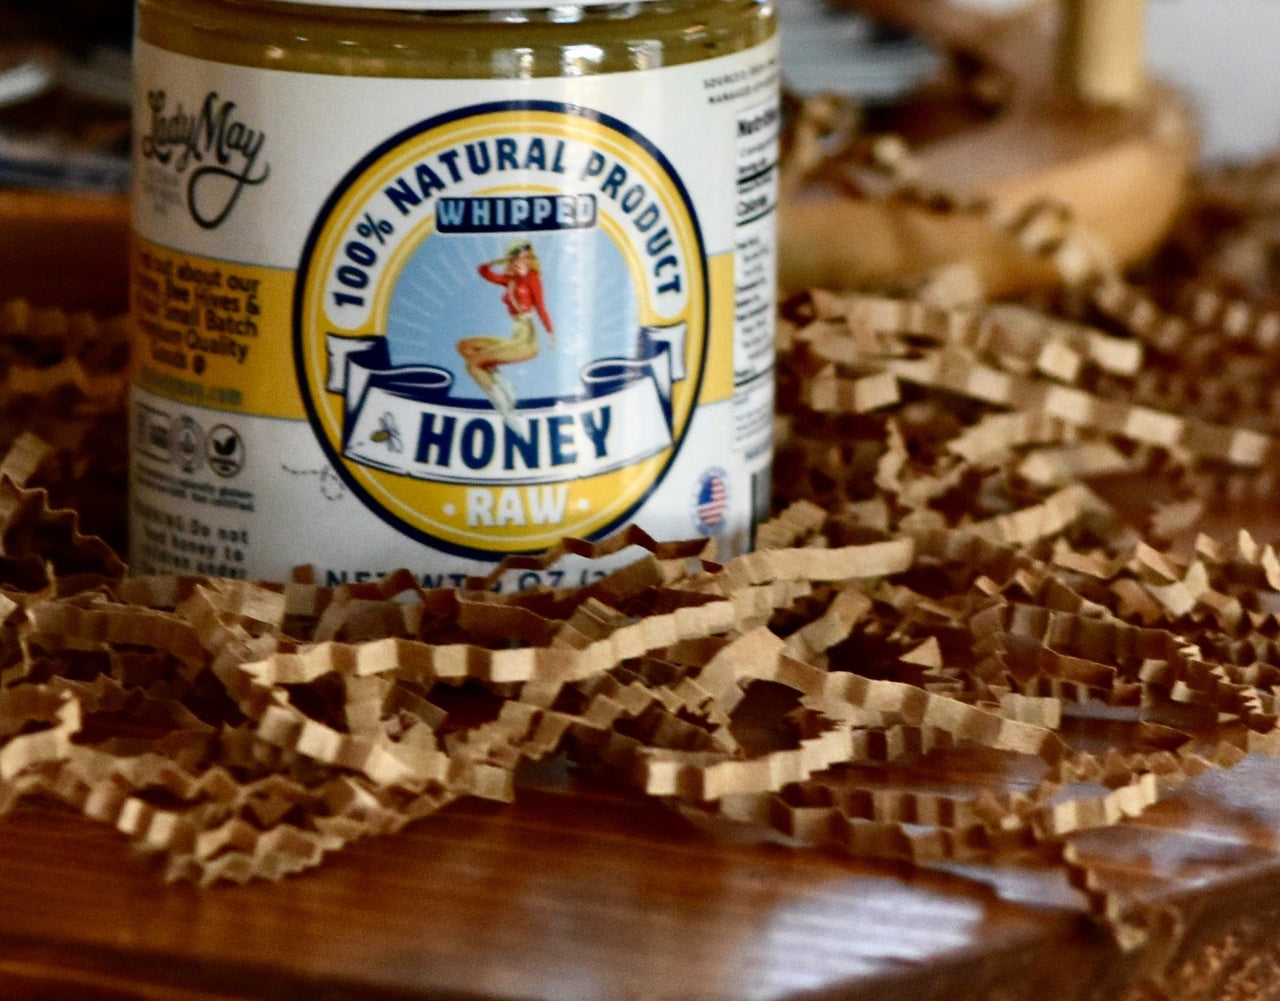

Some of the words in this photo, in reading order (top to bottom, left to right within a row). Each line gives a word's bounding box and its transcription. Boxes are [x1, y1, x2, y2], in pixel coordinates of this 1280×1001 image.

[202, 91, 271, 230] May
[333, 213, 394, 307] 100%
[384, 137, 566, 215] NATURAL
[582, 151, 682, 297] PRODUCT
[438, 199, 594, 227] WHIPPED
[177, 263, 221, 287] about
[227, 275, 261, 292] our
[206, 310, 258, 338] Batch
[186, 328, 249, 363] Quality
[415, 405, 611, 470] HONEY
[466, 487, 567, 527] RAW
[217, 527, 249, 544] not
